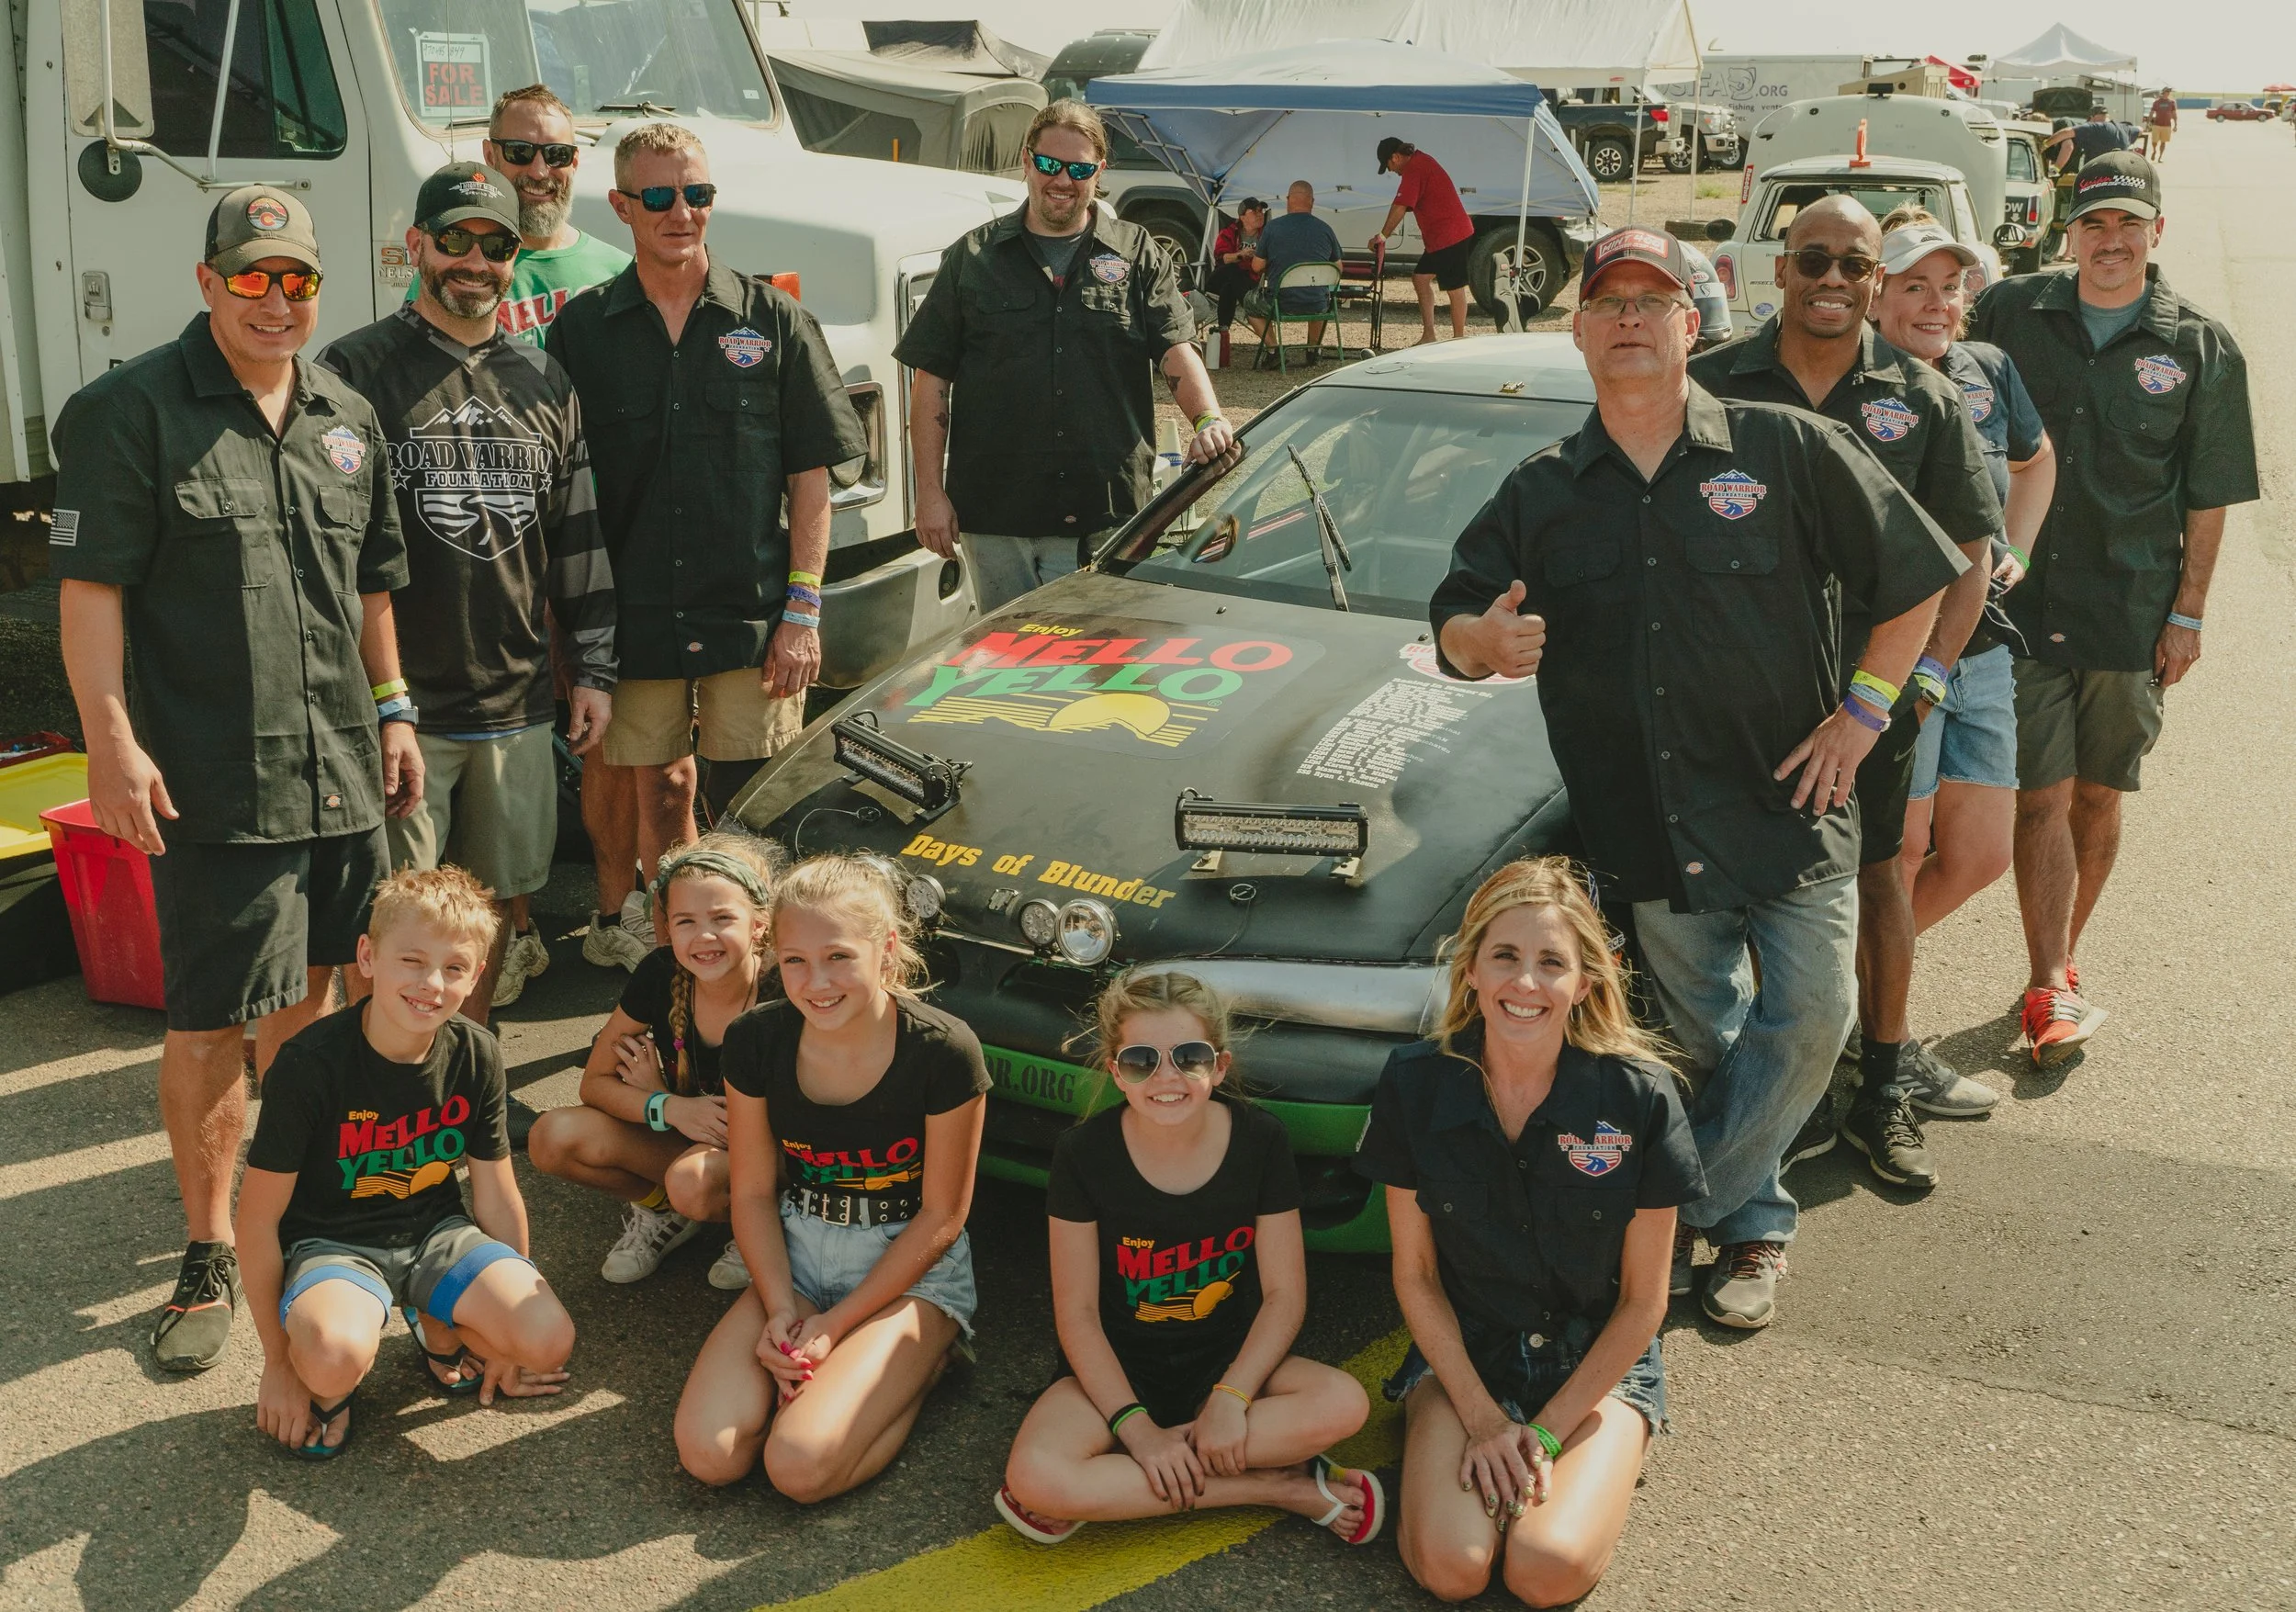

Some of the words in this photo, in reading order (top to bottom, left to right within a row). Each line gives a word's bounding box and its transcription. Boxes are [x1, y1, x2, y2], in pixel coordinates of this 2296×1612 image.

[429, 63, 476, 84] FOR
[425, 85, 485, 106] SALE
[1755, 85, 1788, 97] .ORG
[719, 336, 738, 344] ROAD
[738, 338, 771, 348] WARRIOR
[2136, 358, 2155, 370] ROAD
[2155, 365, 2186, 380] WARRIOR
[1966, 391, 1994, 400] WARRIOR
[1862, 403, 1882, 415] ROAD
[1882, 408, 1919, 423] WARRIOR
[387, 441, 456, 471] ROAD
[459, 442, 553, 475] WARRIO
[1701, 483, 1725, 492] ROAD
[1726, 484, 1766, 494] WARRIOR
[1018, 624, 1085, 637] Enjoy
[943, 632, 1293, 671] MELLO
[904, 664, 1243, 706] YELLO
[901, 834, 983, 866] Days
[992, 854, 1034, 875] of
[1038, 860, 1176, 908] Blunder
[338, 1095, 470, 1158] MELLO
[348, 1110, 379, 1122] Enjoy
[782, 1139, 811, 1150] Enjoy
[1593, 1135, 1632, 1144] ARRIOR
[336, 1128, 465, 1189] YELLO
[784, 1137, 917, 1167] MELLO
[1116, 1226, 1255, 1279] MELLO
[1122, 1236, 1155, 1249] Enjoy
[1124, 1250, 1244, 1308] YELLO
